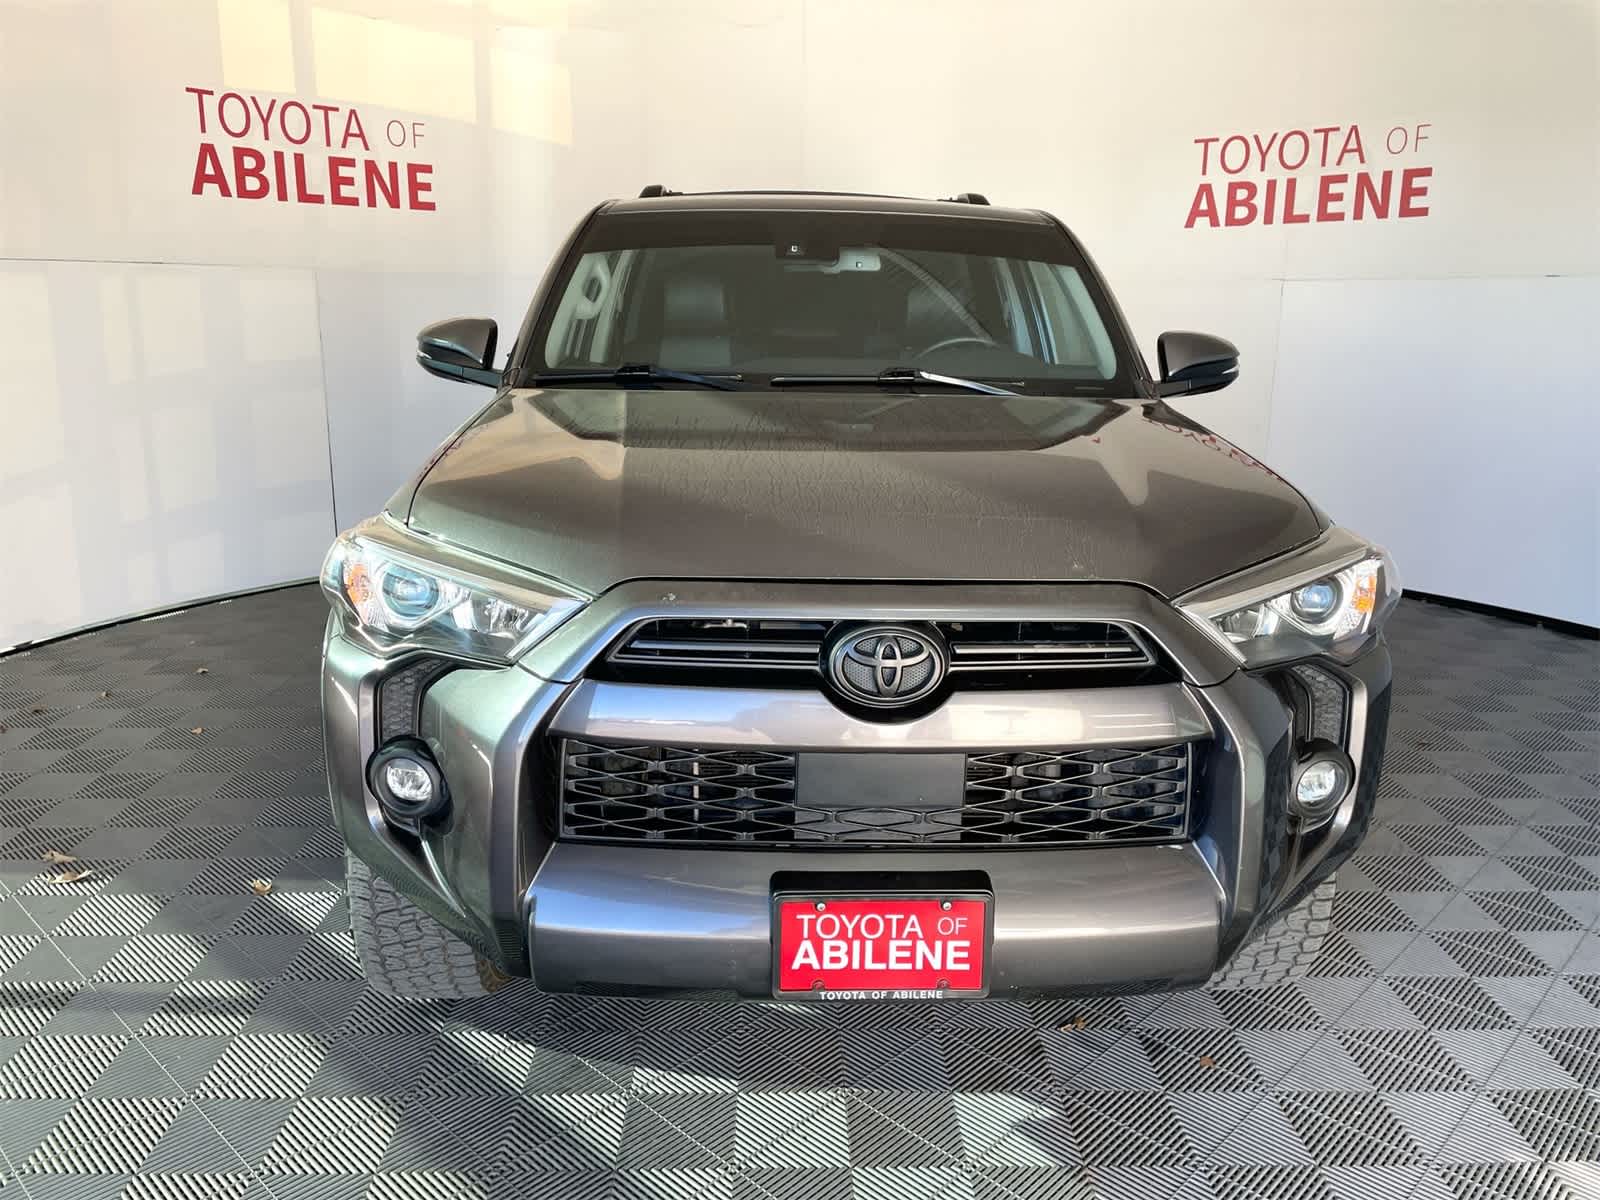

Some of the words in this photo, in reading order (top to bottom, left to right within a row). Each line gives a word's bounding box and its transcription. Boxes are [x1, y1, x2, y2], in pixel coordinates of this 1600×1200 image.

[184, 86, 370, 151] TOYOTA
[386, 119, 425, 149] OF
[191, 142, 438, 212] ABILENE
[1193, 124, 1367, 177] TOYOTA
[1386, 123, 1432, 155] OF
[1183, 166, 1434, 229] ABILENE
[796, 913, 924, 940] TOYOTA
[937, 916, 969, 936] OF
[791, 939, 971, 971] ABILENE
[819, 990, 867, 1001] TOYOTA
[871, 990, 888, 1000] OF
[892, 989, 944, 1000] ABILENE
